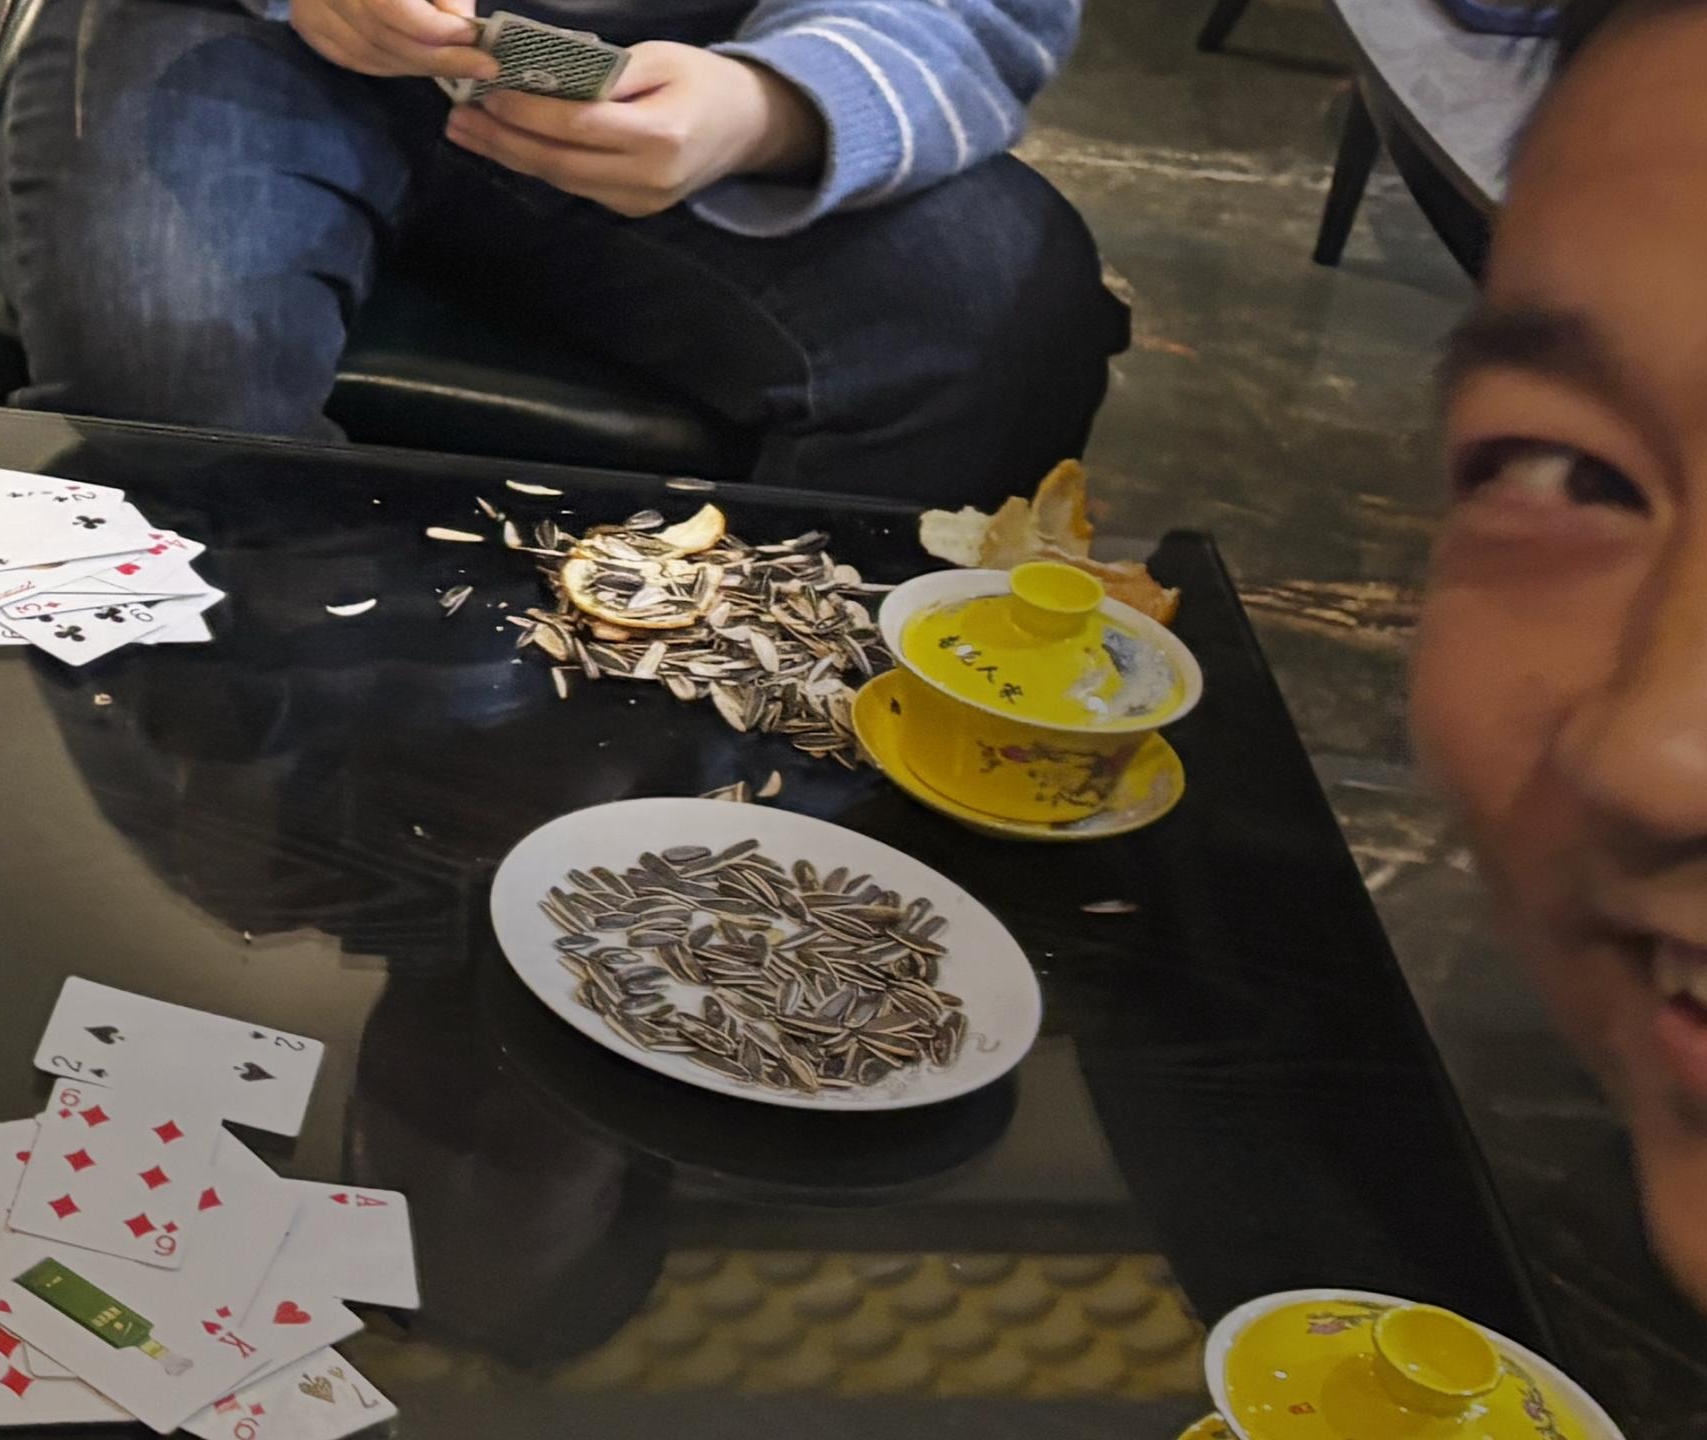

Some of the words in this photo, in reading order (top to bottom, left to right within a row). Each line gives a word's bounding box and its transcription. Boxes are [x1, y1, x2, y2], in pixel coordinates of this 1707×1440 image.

[72, 491, 97, 501] 2
[16, 602, 42, 614] 3
[274, 1036, 306, 1052] 2
[51, 1055, 83, 1073] 2
[59, 1088, 82, 1108] 6
[355, 1194, 389, 1208] A
[217, 1331, 258, 1359] K
